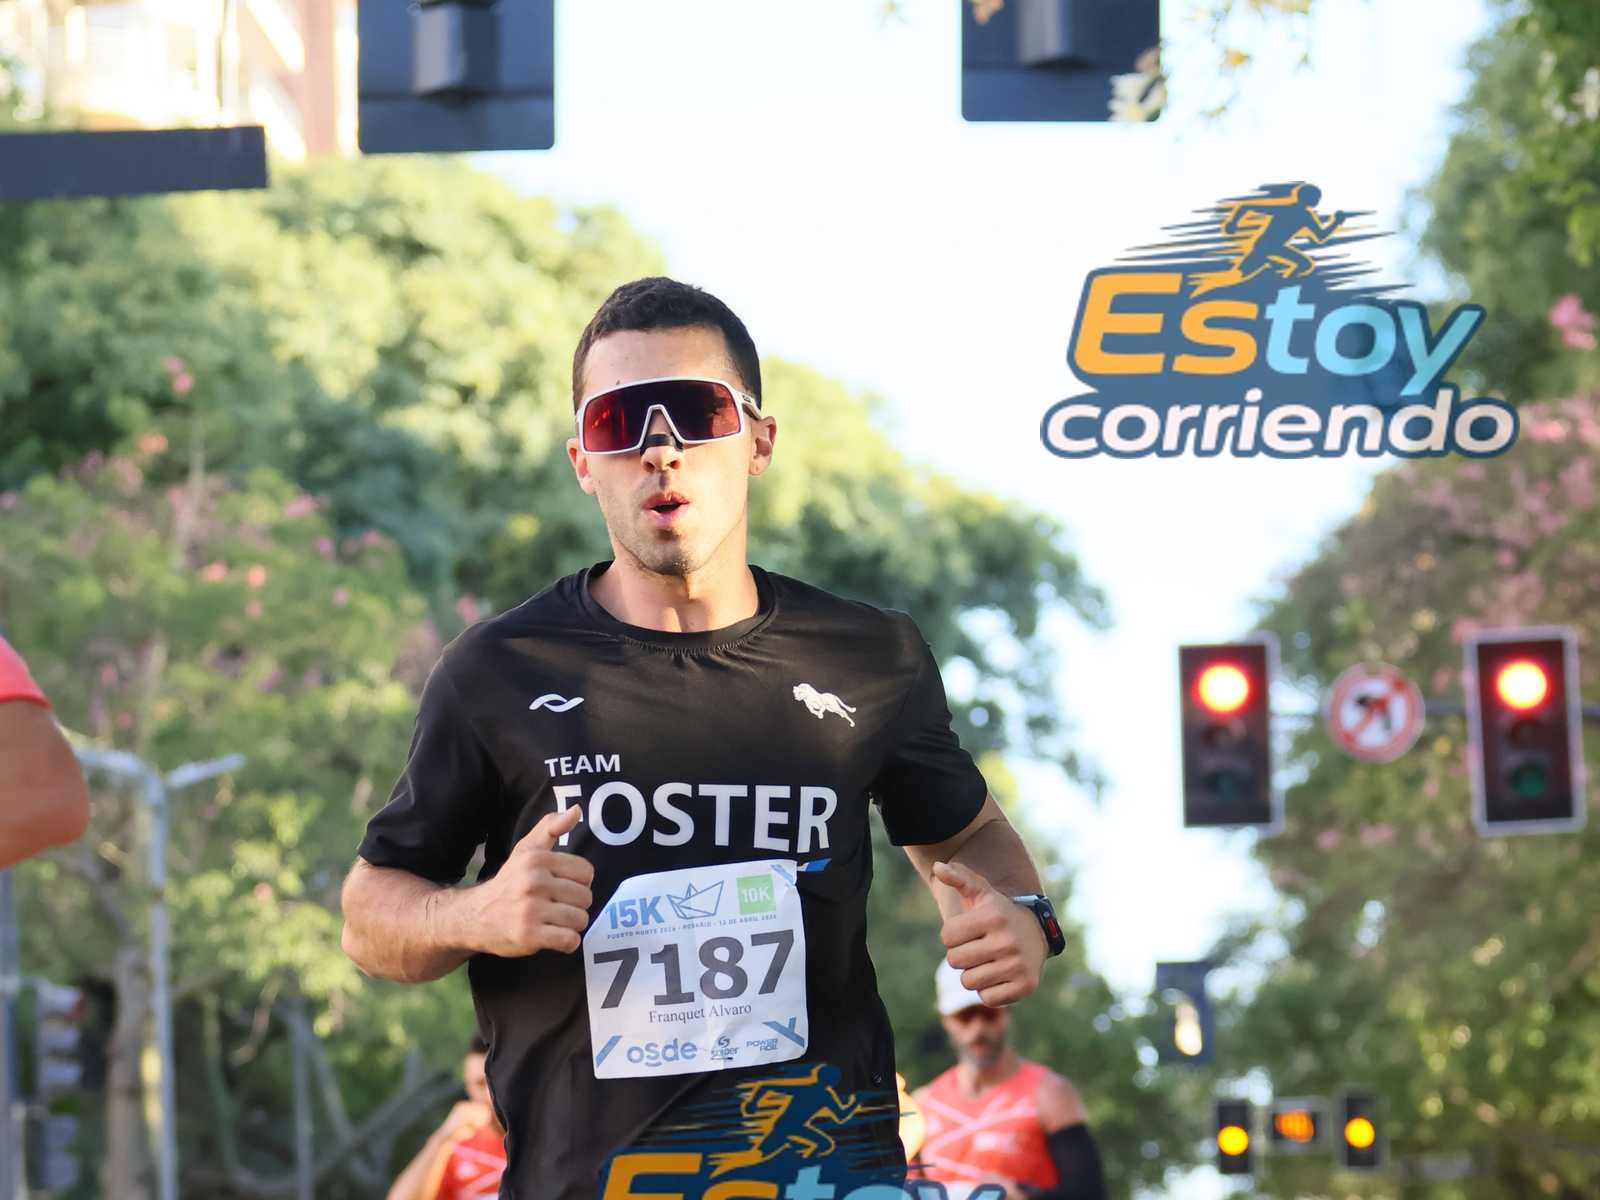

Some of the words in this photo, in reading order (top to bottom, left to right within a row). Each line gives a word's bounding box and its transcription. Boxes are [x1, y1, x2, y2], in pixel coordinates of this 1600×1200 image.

[544, 753, 621, 777] TEAM
[552, 781, 838, 854] FOSTER
[741, 886, 772, 903] 10K
[606, 895, 665, 930] 15K
[593, 929, 795, 1010] 7187
[649, 1009, 705, 1024] Franquet
[626, 1037, 698, 1064] osde
